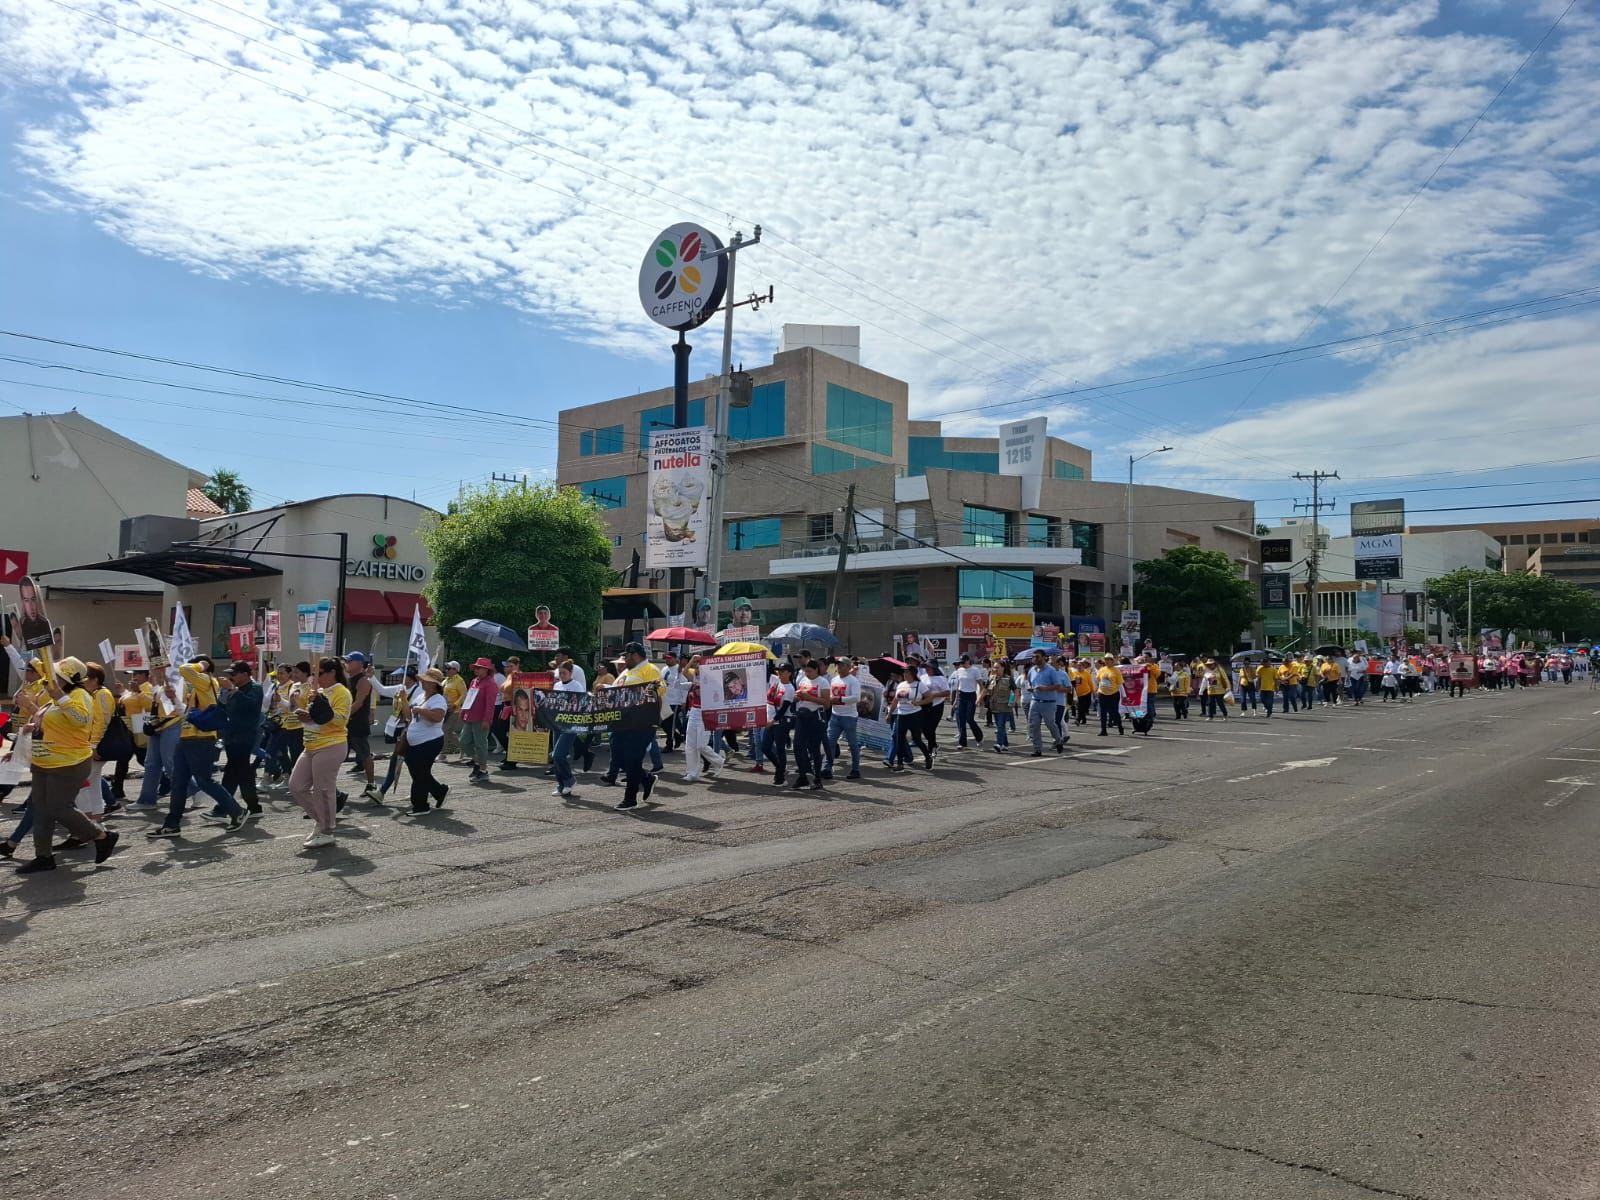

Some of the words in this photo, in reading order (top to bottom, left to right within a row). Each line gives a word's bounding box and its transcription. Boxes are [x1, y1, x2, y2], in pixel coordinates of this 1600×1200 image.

[652, 297, 702, 317] CAFFENIO
[655, 436, 701, 448] AFFOGATOS
[654, 452, 701, 470] nutella
[1006, 446, 1032, 465] 1215
[1360, 539, 1393, 549] MGM
[345, 559, 426, 581] CAFFENIO
[725, 652, 762, 662] ENCONTRARTE!
